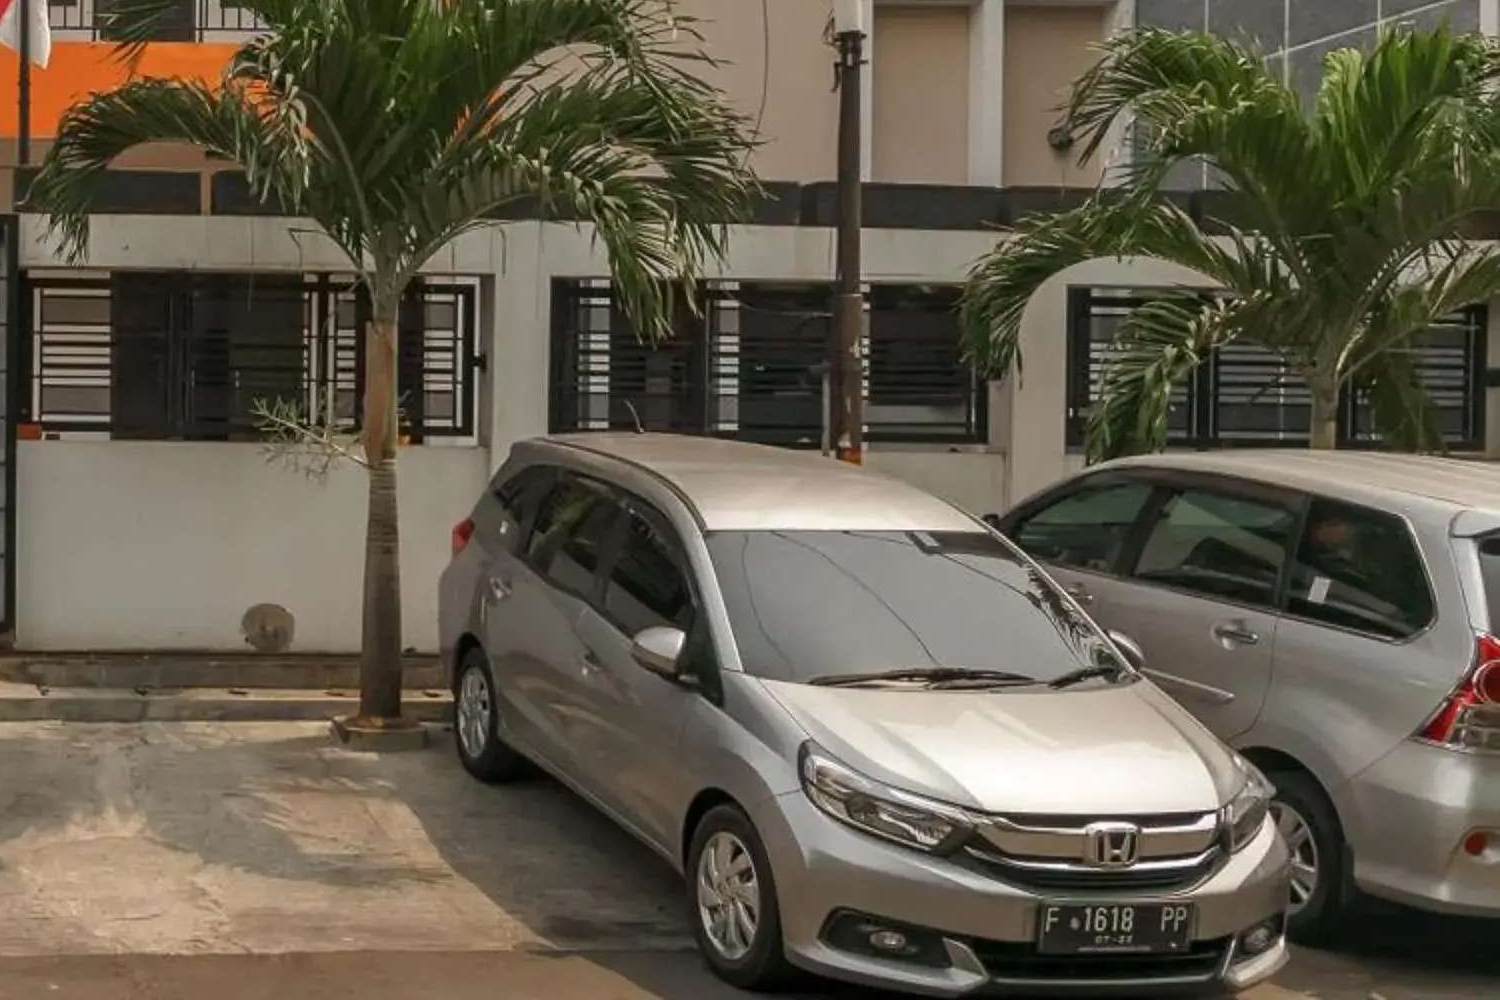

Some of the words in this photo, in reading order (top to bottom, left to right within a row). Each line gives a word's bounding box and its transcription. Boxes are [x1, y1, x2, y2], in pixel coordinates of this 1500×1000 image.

[1045, 906, 1061, 933] F
[1084, 906, 1135, 933] 1618
[1160, 906, 1188, 933] PP
